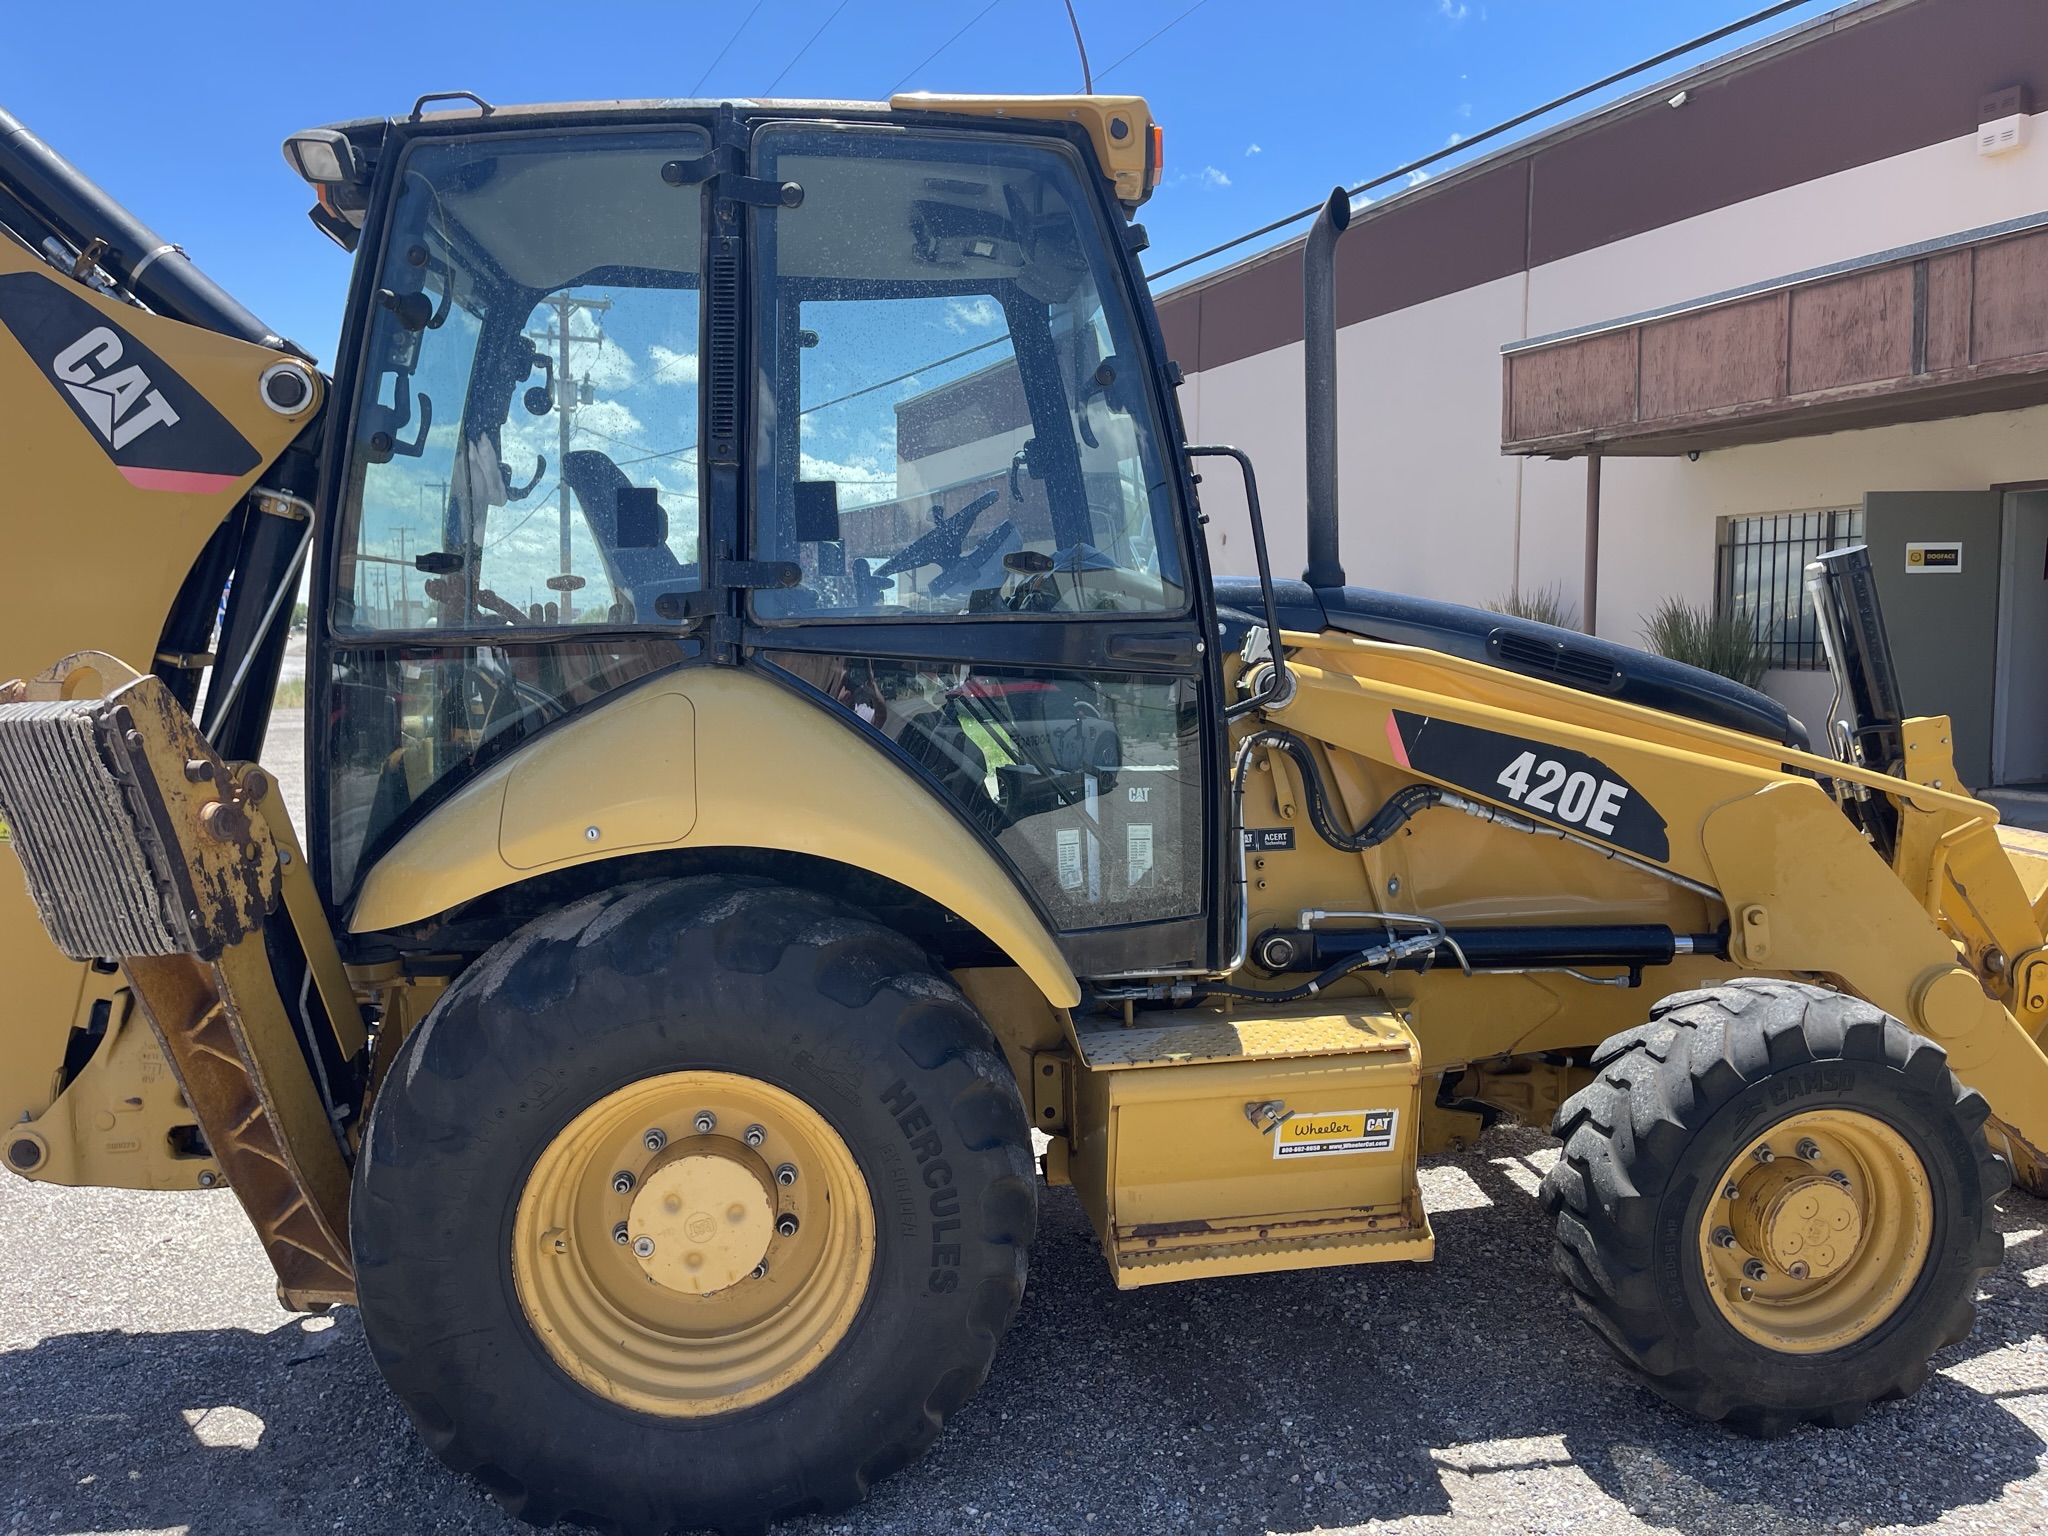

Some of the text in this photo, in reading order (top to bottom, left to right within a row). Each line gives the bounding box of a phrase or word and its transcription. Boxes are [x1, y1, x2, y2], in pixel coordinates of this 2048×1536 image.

[54, 326, 180, 451] CAT
[1128, 787, 1150, 803] CAT
[1496, 750, 1629, 836] 420E
[1244, 833, 1253, 843] AT
[1264, 832, 1288, 841] ACERT
[1294, 1121, 1352, 1137] Wheeler
[1366, 1117, 1391, 1132] CAT
[1328, 1140, 1388, 1151] www.WheelerCat.com
[879, 1078, 961, 1295] HERCULES
